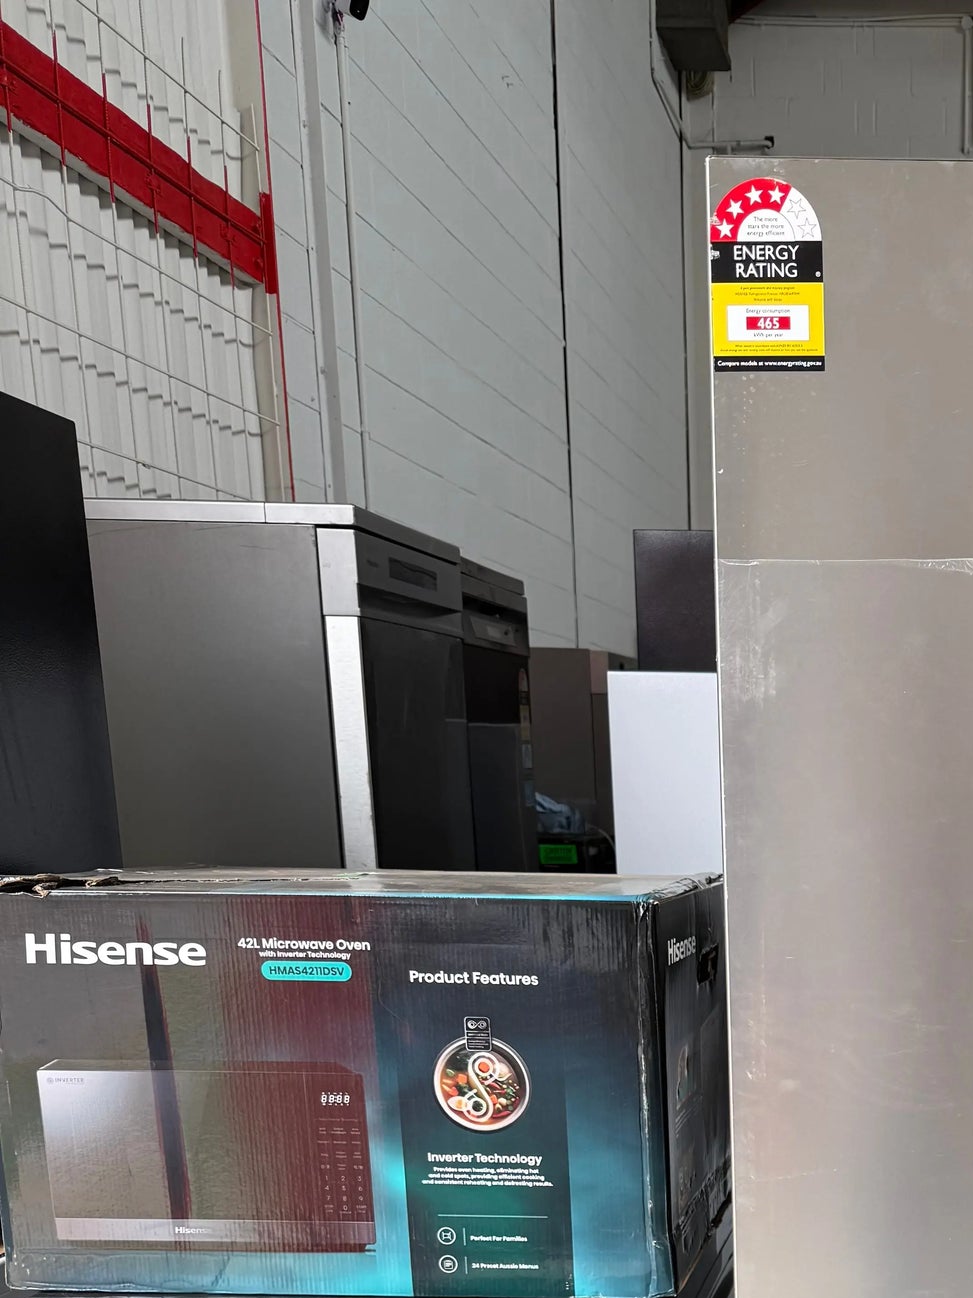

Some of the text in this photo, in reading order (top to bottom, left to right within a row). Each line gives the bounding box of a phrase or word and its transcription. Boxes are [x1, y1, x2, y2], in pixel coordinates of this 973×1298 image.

[733, 244, 799, 260] ENERGY
[735, 262, 798, 278] RATING
[757, 317, 780, 329] 465
[717, 360, 739, 368] Compare
[25, 933, 207, 967] Hisense
[237, 937, 371, 951] 42L Microwave Oven
[667, 935, 696, 966] Hisense
[259, 950, 276, 958] with
[307, 951, 351, 960] Technology
[269, 966, 344, 976] HMAS4211DSV
[409, 970, 539, 986] Product Features
[427, 1152, 542, 1167] Inverter Technology
